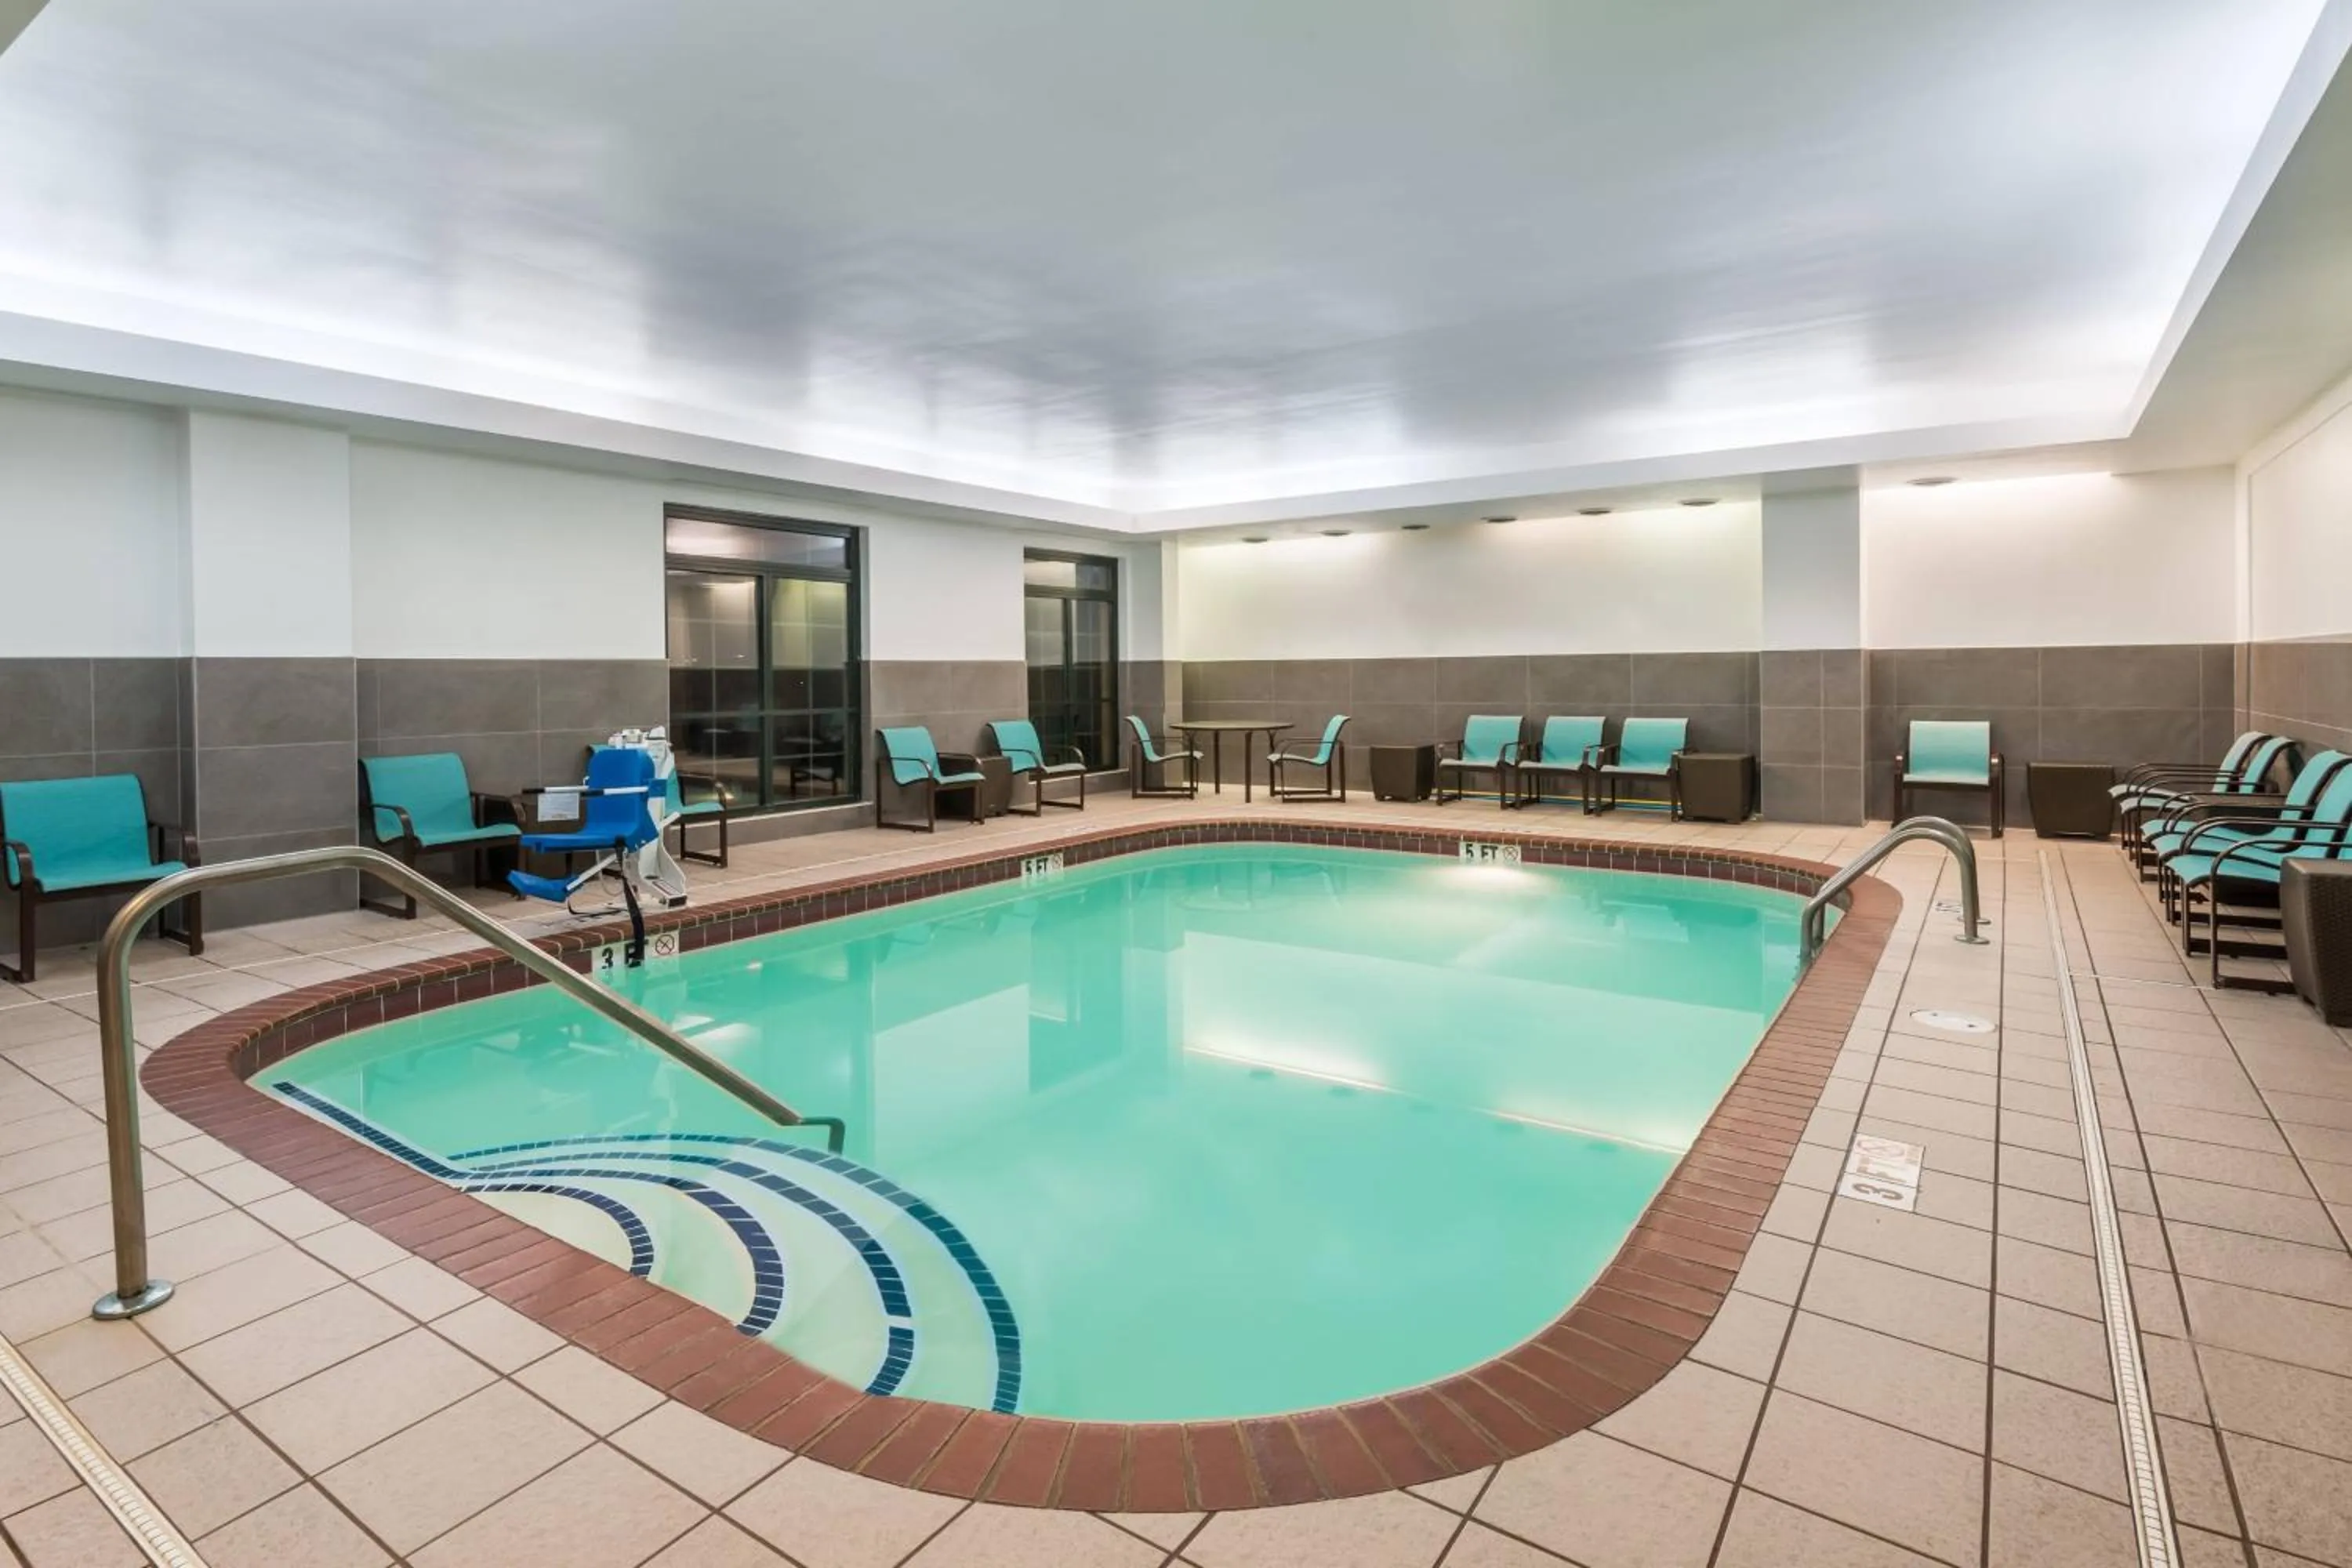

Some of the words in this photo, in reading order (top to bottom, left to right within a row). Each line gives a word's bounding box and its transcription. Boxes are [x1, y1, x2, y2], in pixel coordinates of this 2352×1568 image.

[1480, 844, 1498, 860] FT
[1036, 858, 1049, 873] FT
[601, 946, 614, 970] 3
[1852, 1182, 1904, 1201] 3
